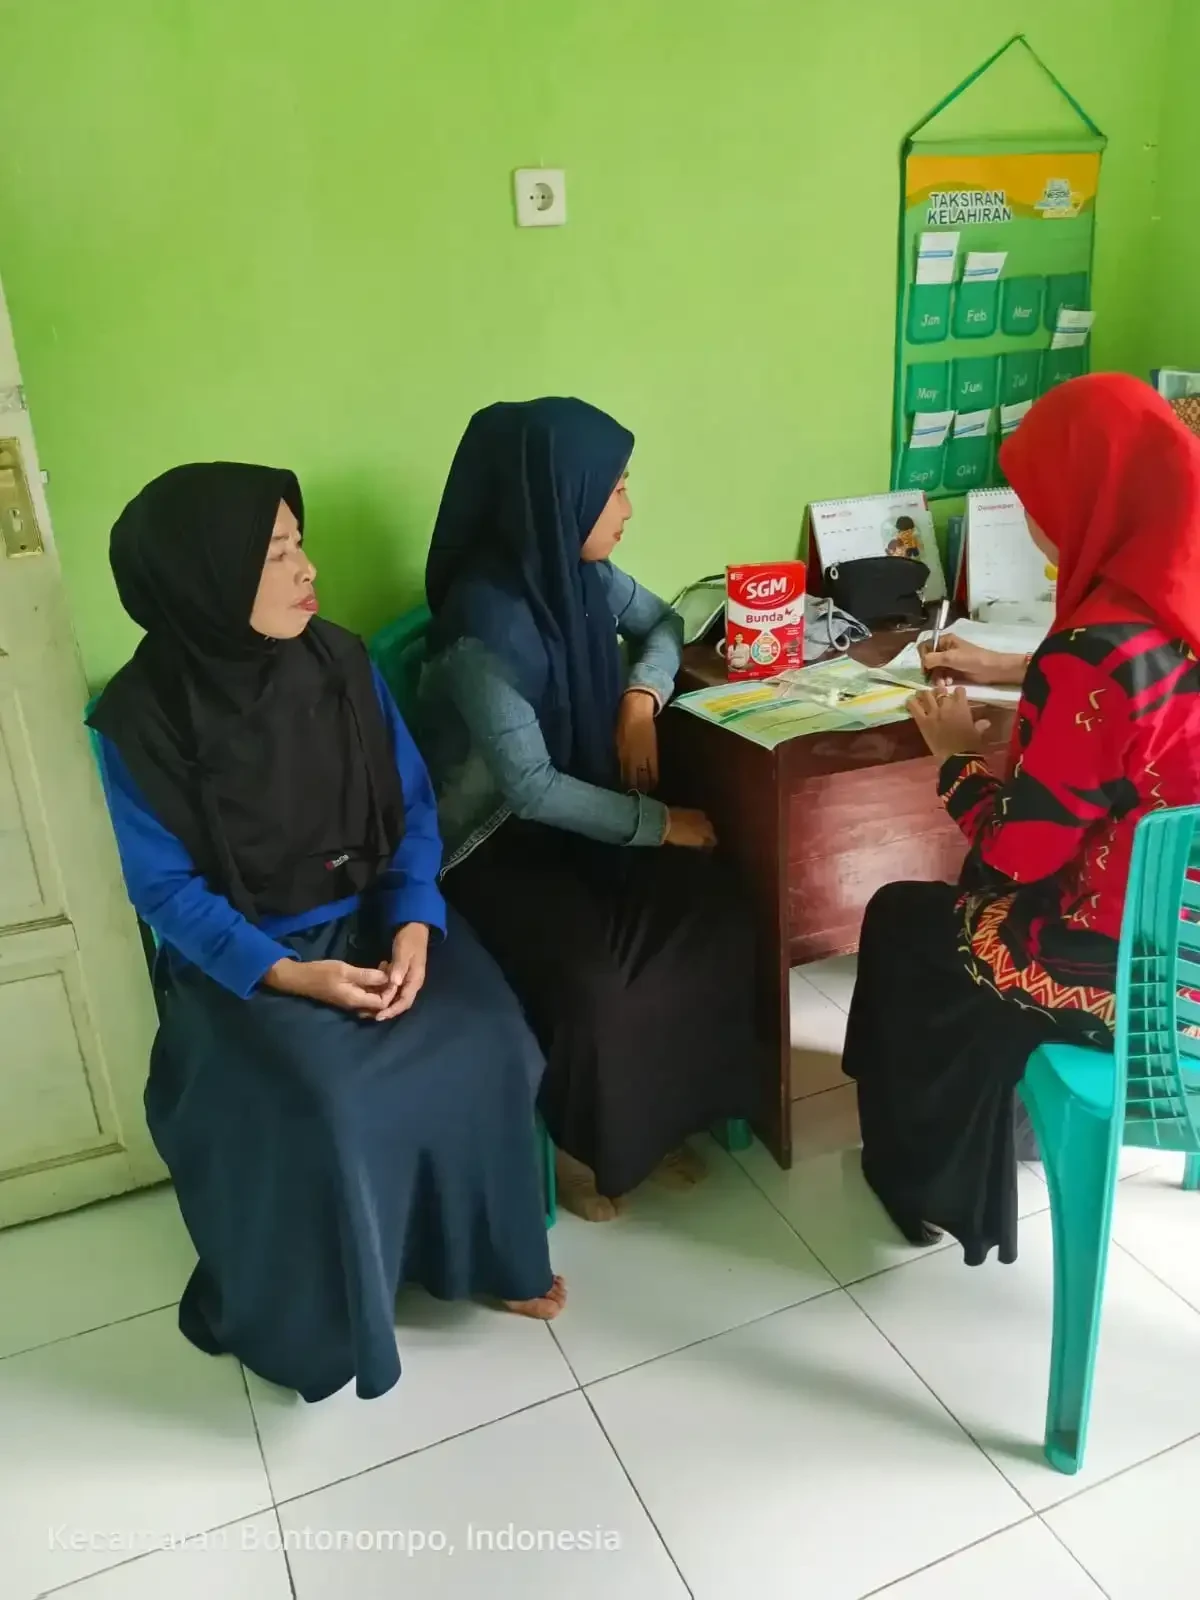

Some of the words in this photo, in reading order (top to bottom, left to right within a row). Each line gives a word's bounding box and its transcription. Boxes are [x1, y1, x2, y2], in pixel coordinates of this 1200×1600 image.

[931, 191, 1005, 208] TAKSIRAN
[927, 207, 1012, 224] KELAHIRAN
[967, 310, 988, 323] Feb
[1013, 307, 1033, 319] Mar
[921, 314, 941, 327] Jan
[961, 382, 983, 394] Jun
[910, 469, 934, 483] Sept
[956, 464, 977, 477] Okt
[746, 576, 787, 600] SGM
[746, 613, 784, 624] Bunda
